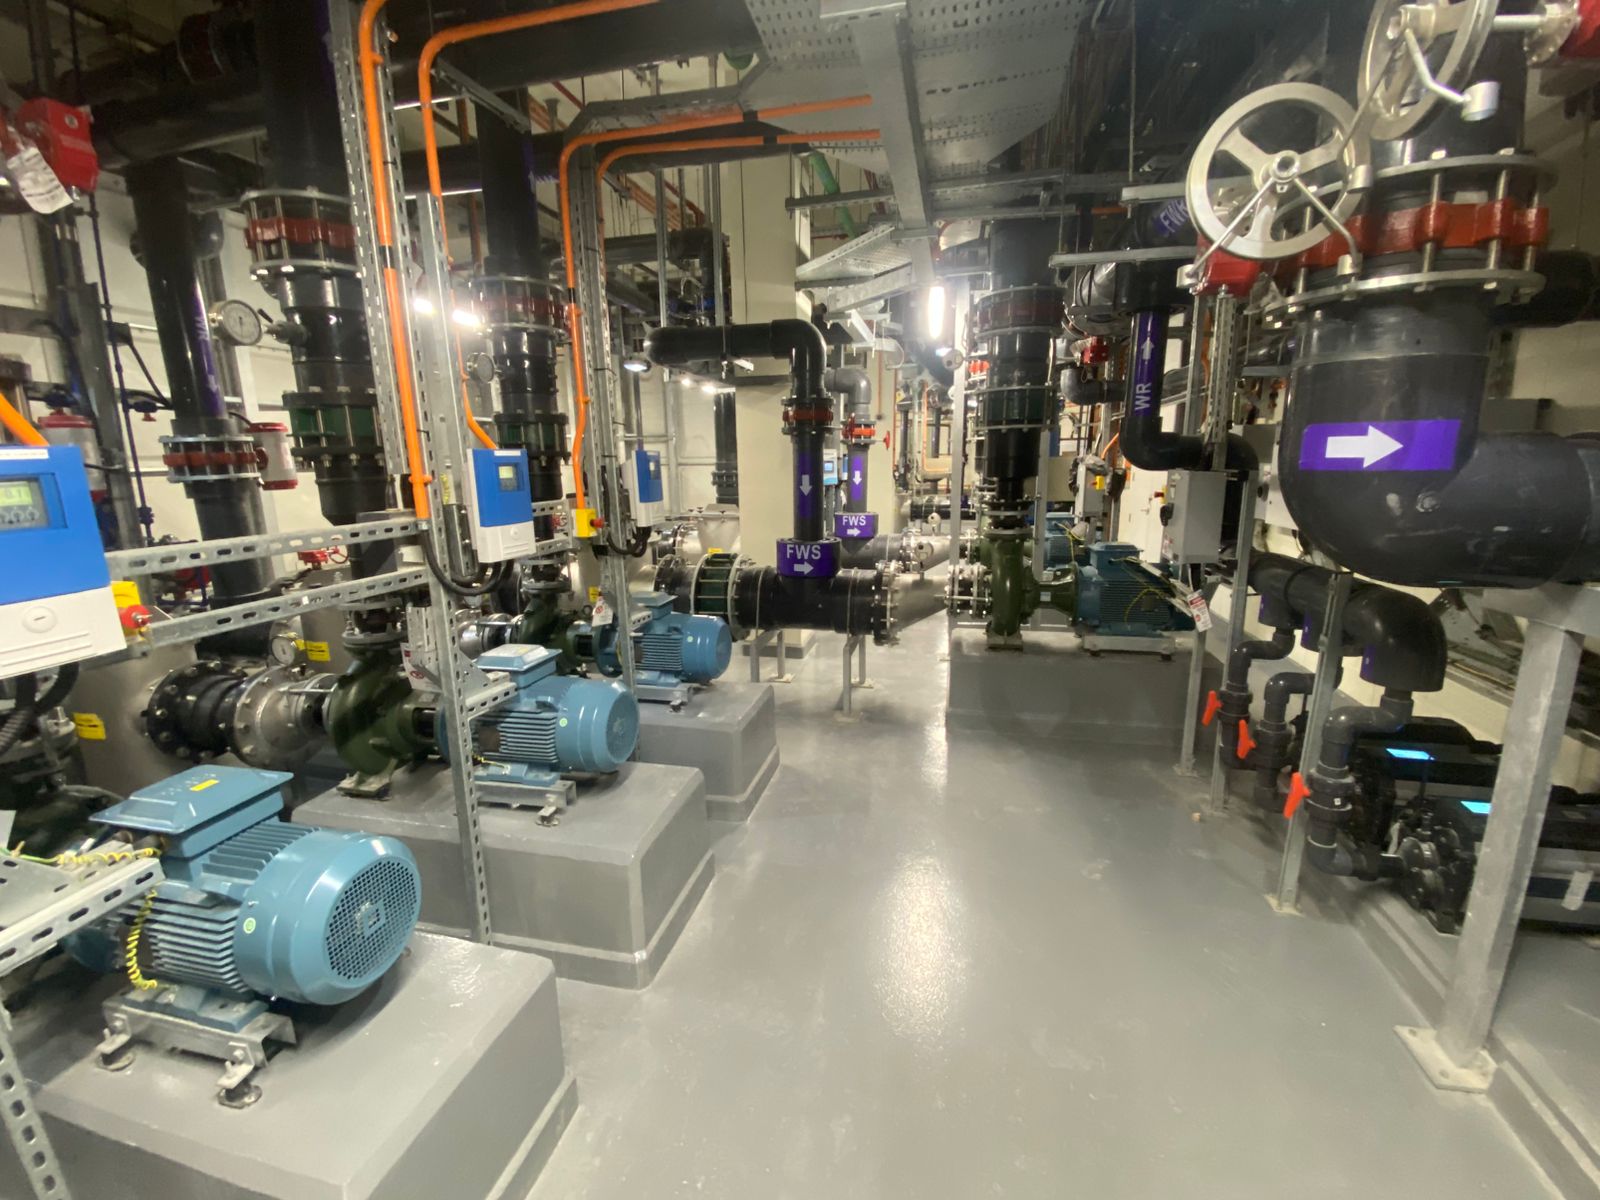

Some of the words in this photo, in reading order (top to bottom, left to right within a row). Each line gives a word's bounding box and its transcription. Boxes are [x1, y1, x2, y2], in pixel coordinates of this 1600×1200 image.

[1134, 382, 1152, 410] WR
[842, 515, 867, 526] FWS
[786, 544, 821, 560] FWS
